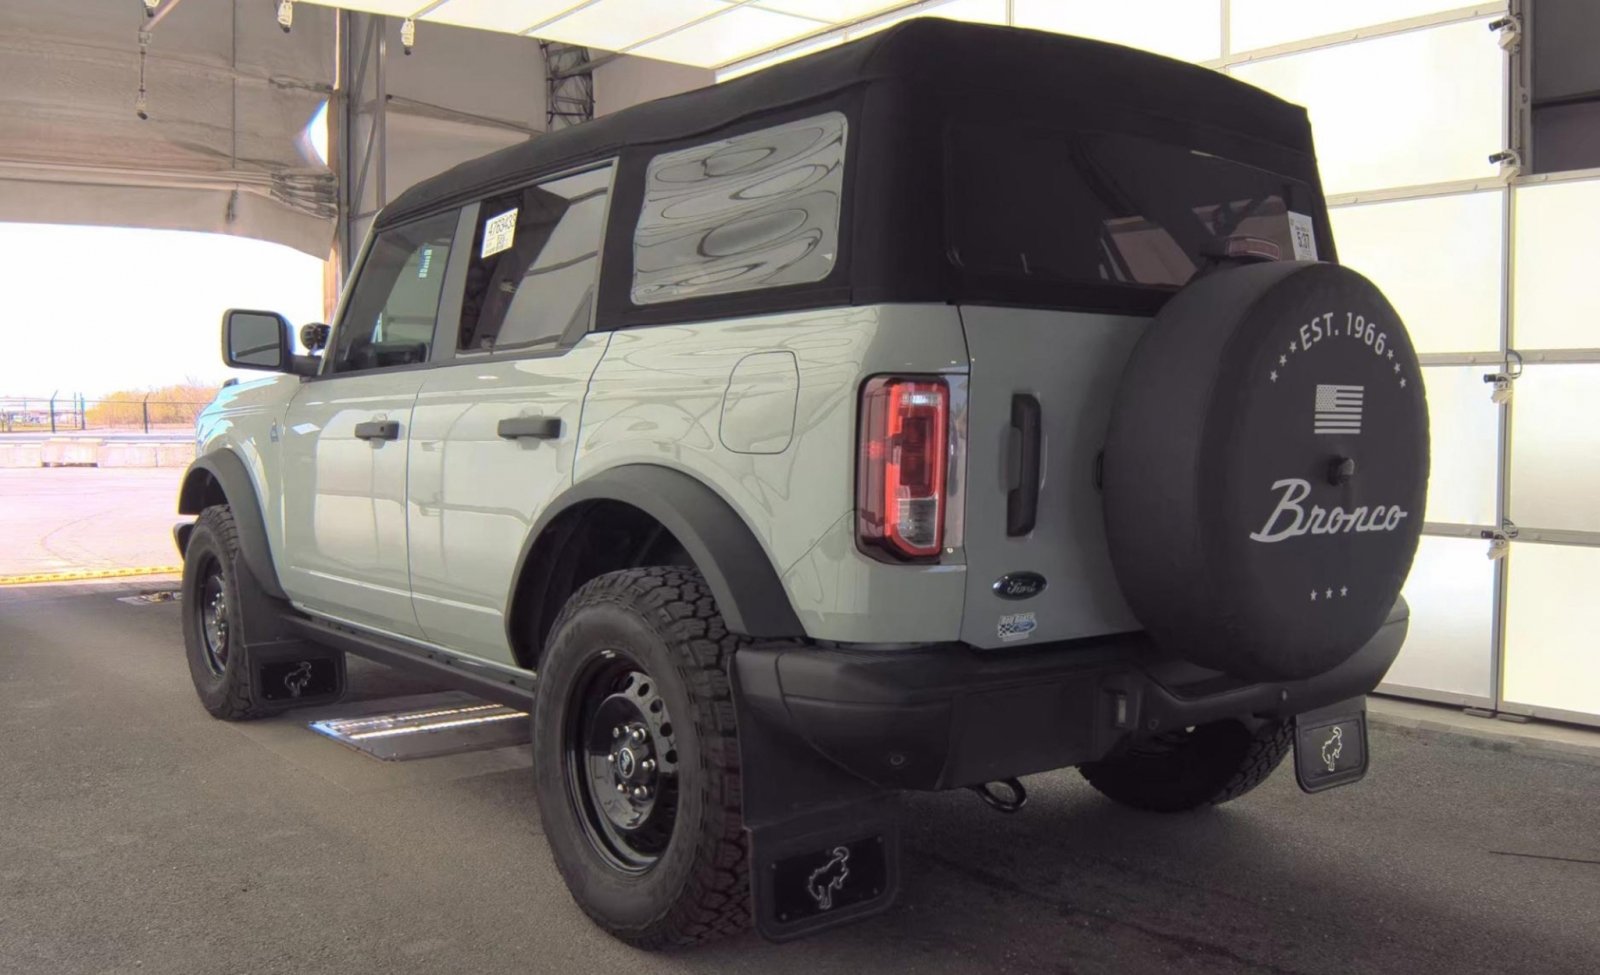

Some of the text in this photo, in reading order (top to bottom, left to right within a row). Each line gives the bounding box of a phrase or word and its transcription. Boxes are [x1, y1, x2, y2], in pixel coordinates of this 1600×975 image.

[1299, 312, 1387, 355] EST. 1966
[1249, 478, 1408, 543] Bronco
[1006, 580, 1037, 594] Ford
